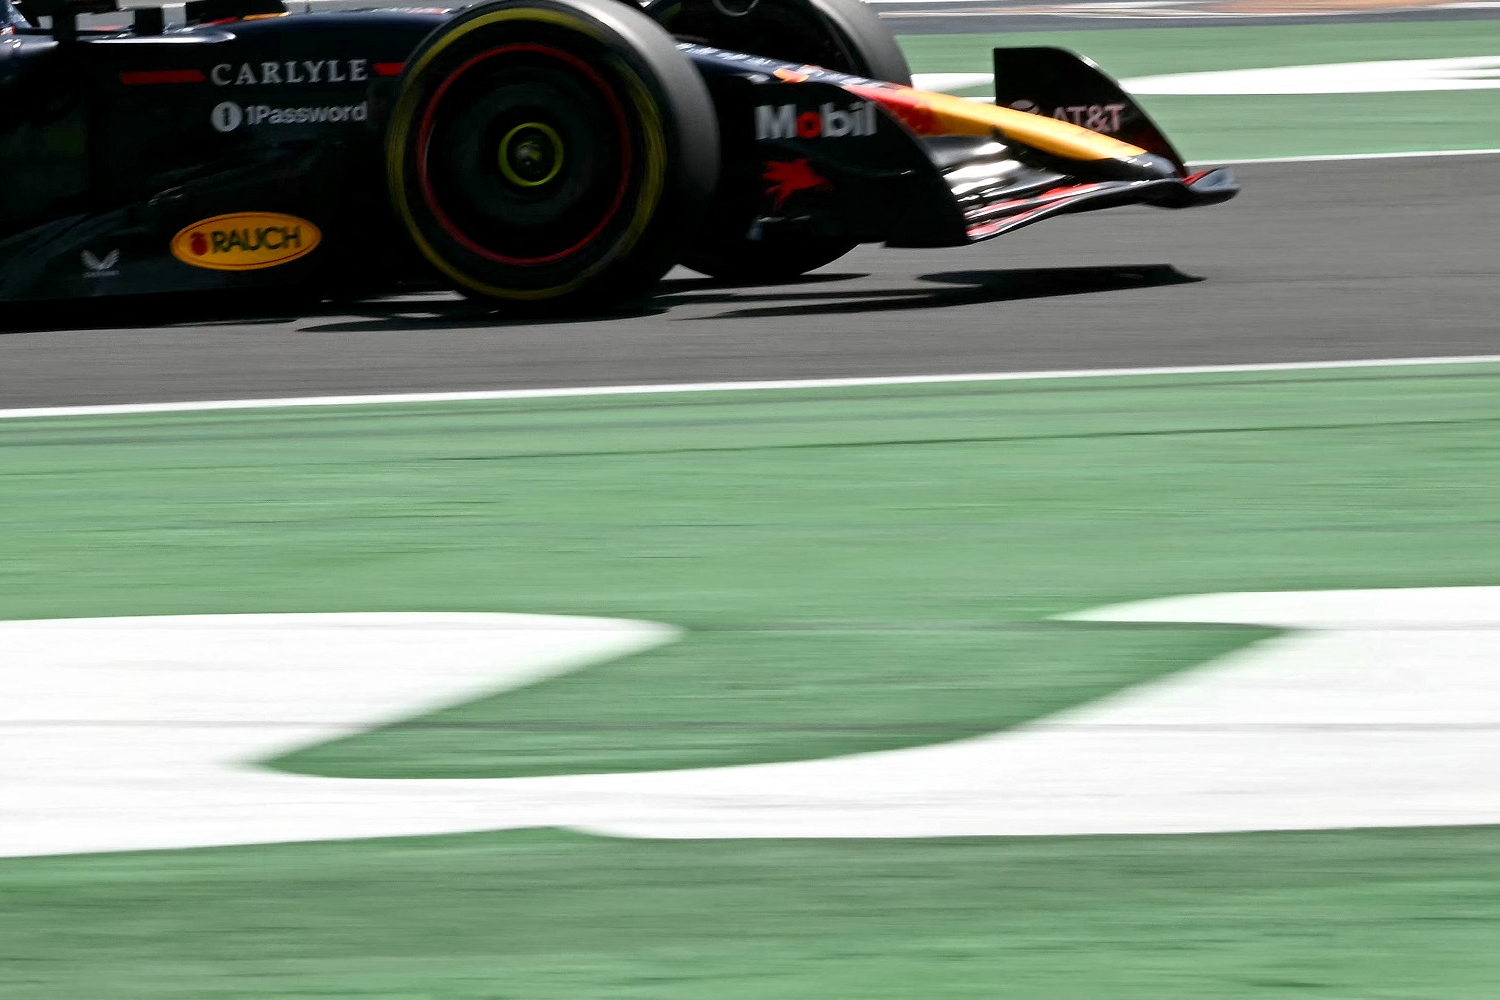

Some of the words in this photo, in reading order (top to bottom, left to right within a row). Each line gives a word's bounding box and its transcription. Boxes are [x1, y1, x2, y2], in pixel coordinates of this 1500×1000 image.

[211, 59, 368, 85] CARLYLE
[246, 102, 368, 125] 1Password
[755, 102, 877, 140] Mobil
[1052, 104, 1126, 133] AT&T
[211, 227, 300, 253] RAUCH
